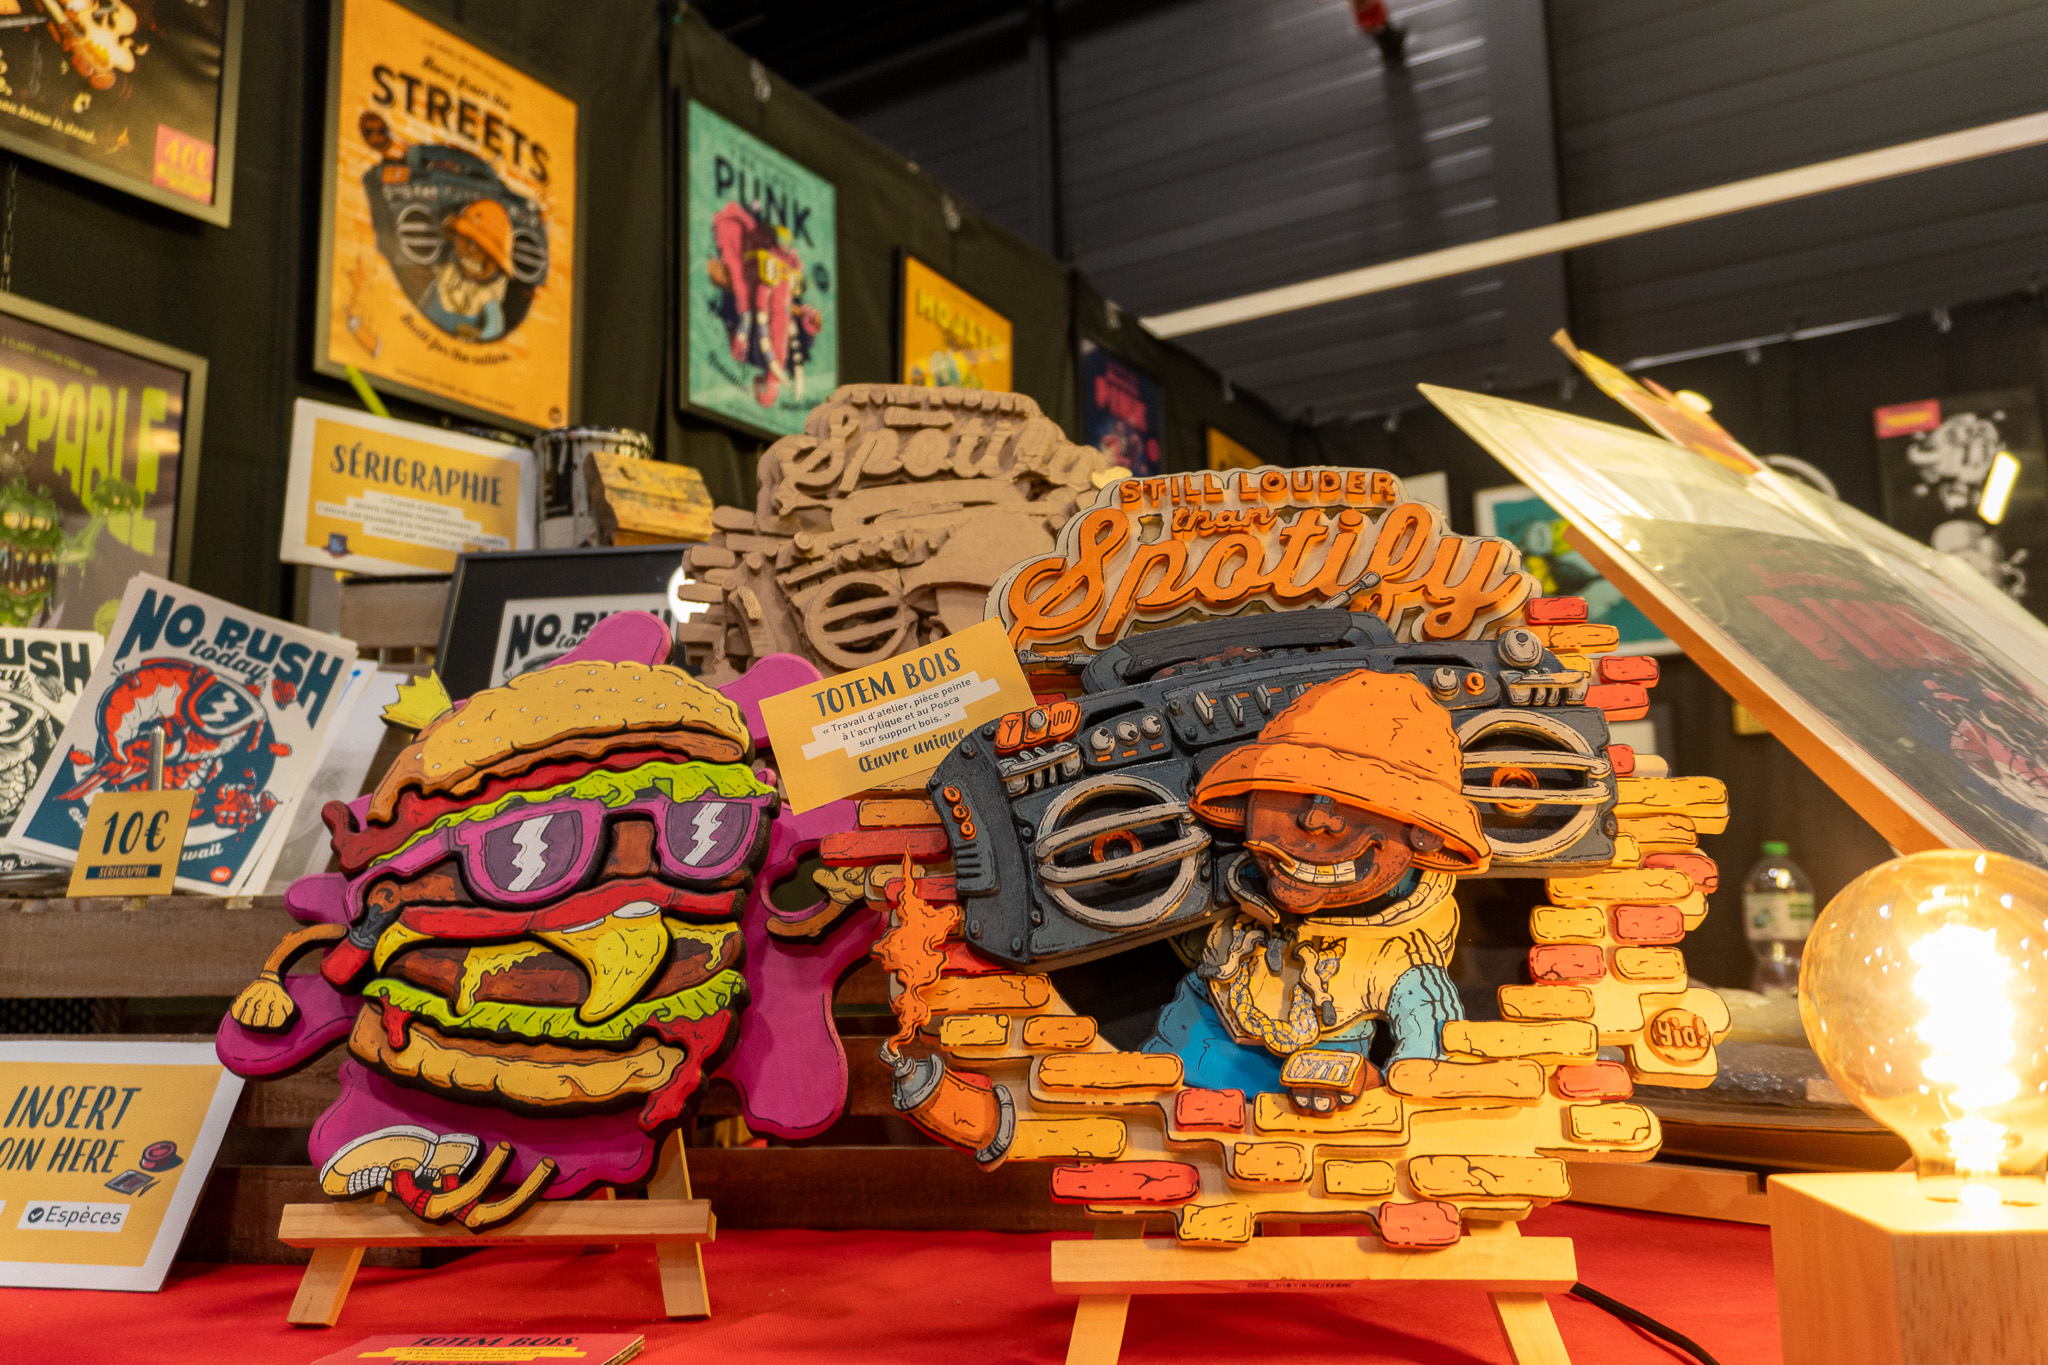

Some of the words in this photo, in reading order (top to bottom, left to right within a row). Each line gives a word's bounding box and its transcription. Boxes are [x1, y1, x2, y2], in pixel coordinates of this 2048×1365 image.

[371, 63, 549, 186] STREETS
[714, 154, 815, 249] PUNK
[330, 441, 504, 507] SÉRIGRAPHIE
[1119, 473, 1224, 511] STILL
[1238, 470, 1396, 505] LOUDER
[1171, 505, 1278, 542] than
[1008, 503, 1526, 646] Spotify
[113, 588, 205, 661] NO
[214, 617, 344, 730] RUSH
[189, 639, 270, 686] today
[503, 612, 562, 673] NO
[811, 671, 896, 717] TOTEM
[902, 647, 961, 690] BOIS
[830, 715, 866, 733] Travail
[868, 702, 912, 722] d'atelier,
[914, 691, 940, 708] pièce
[942, 679, 972, 698] peinte
[842, 732, 849, 741] à
[850, 717, 903, 739] l'acrylique
[904, 711, 915, 722] et
[916, 707, 929, 718] au
[930, 696, 960, 713] Posca
[858, 747, 910, 773] Œuvre
[913, 727, 965, 756] unique
[859, 737, 876, 748] sur
[878, 724, 917, 743] support
[918, 714, 943, 729] bois.
[102, 810, 169, 855] 10€
[181, 842, 224, 861] wait
[1655, 1016, 1709, 1050] Yio!
[3, 1085, 142, 1131] INSERT
[46, 1136, 125, 1174] HERE
[45, 1205, 123, 1229] Espèces
[411, 1337, 504, 1347] TOTEM
[508, 1336, 580, 1347] BOIS
